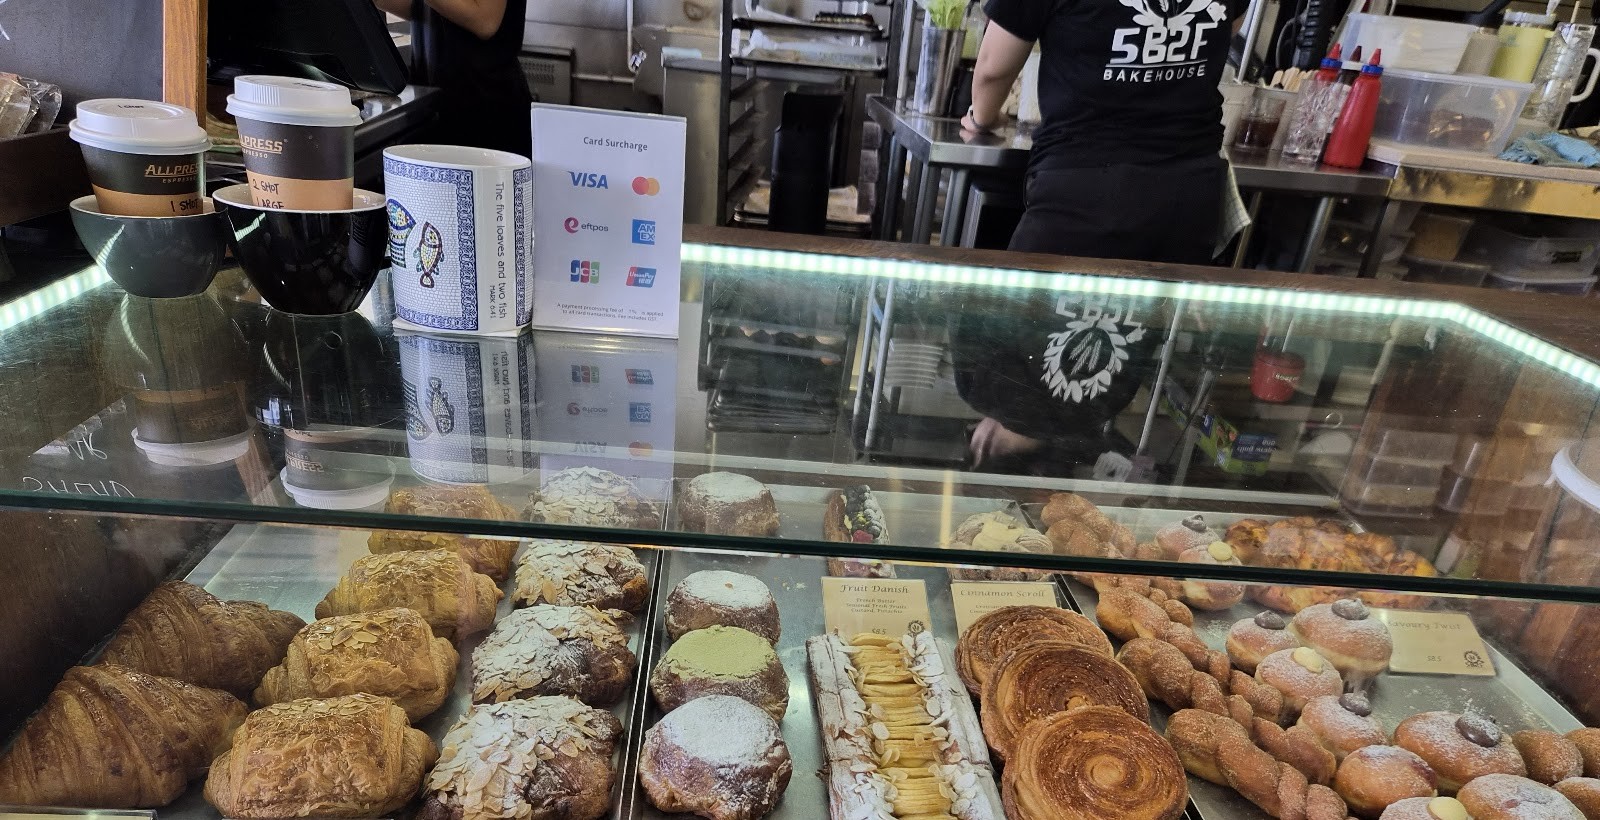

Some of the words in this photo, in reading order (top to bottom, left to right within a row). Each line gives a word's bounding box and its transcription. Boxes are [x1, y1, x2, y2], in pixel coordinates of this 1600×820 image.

[1103, 65, 1206, 83] BAKEHOUSE
[583, 136, 603, 146] Card
[605, 138, 648, 152] Surcharge
[252, 178, 260, 190] 2
[260, 180, 280, 195] SHOT
[567, 170, 609, 189] VISA
[495, 181, 505, 201] The
[170, 200, 176, 212] 1
[179, 198, 198, 211] SHOT
[496, 204, 505, 222] five
[581, 222, 609, 232] eftpos
[638, 223, 655, 233] AM
[497, 225, 506, 257] loaves
[640, 232, 655, 241] EX
[498, 261, 506, 279] and
[498, 282, 506, 299] two
[499, 301, 507, 319] fish
[840, 584, 868, 593] Fruit
[871, 585, 909, 594] Danish
[960, 589, 1013, 597] Cinnamon
[1016, 589, 1046, 598] Scroll
[1432, 622, 1461, 630] Twist
